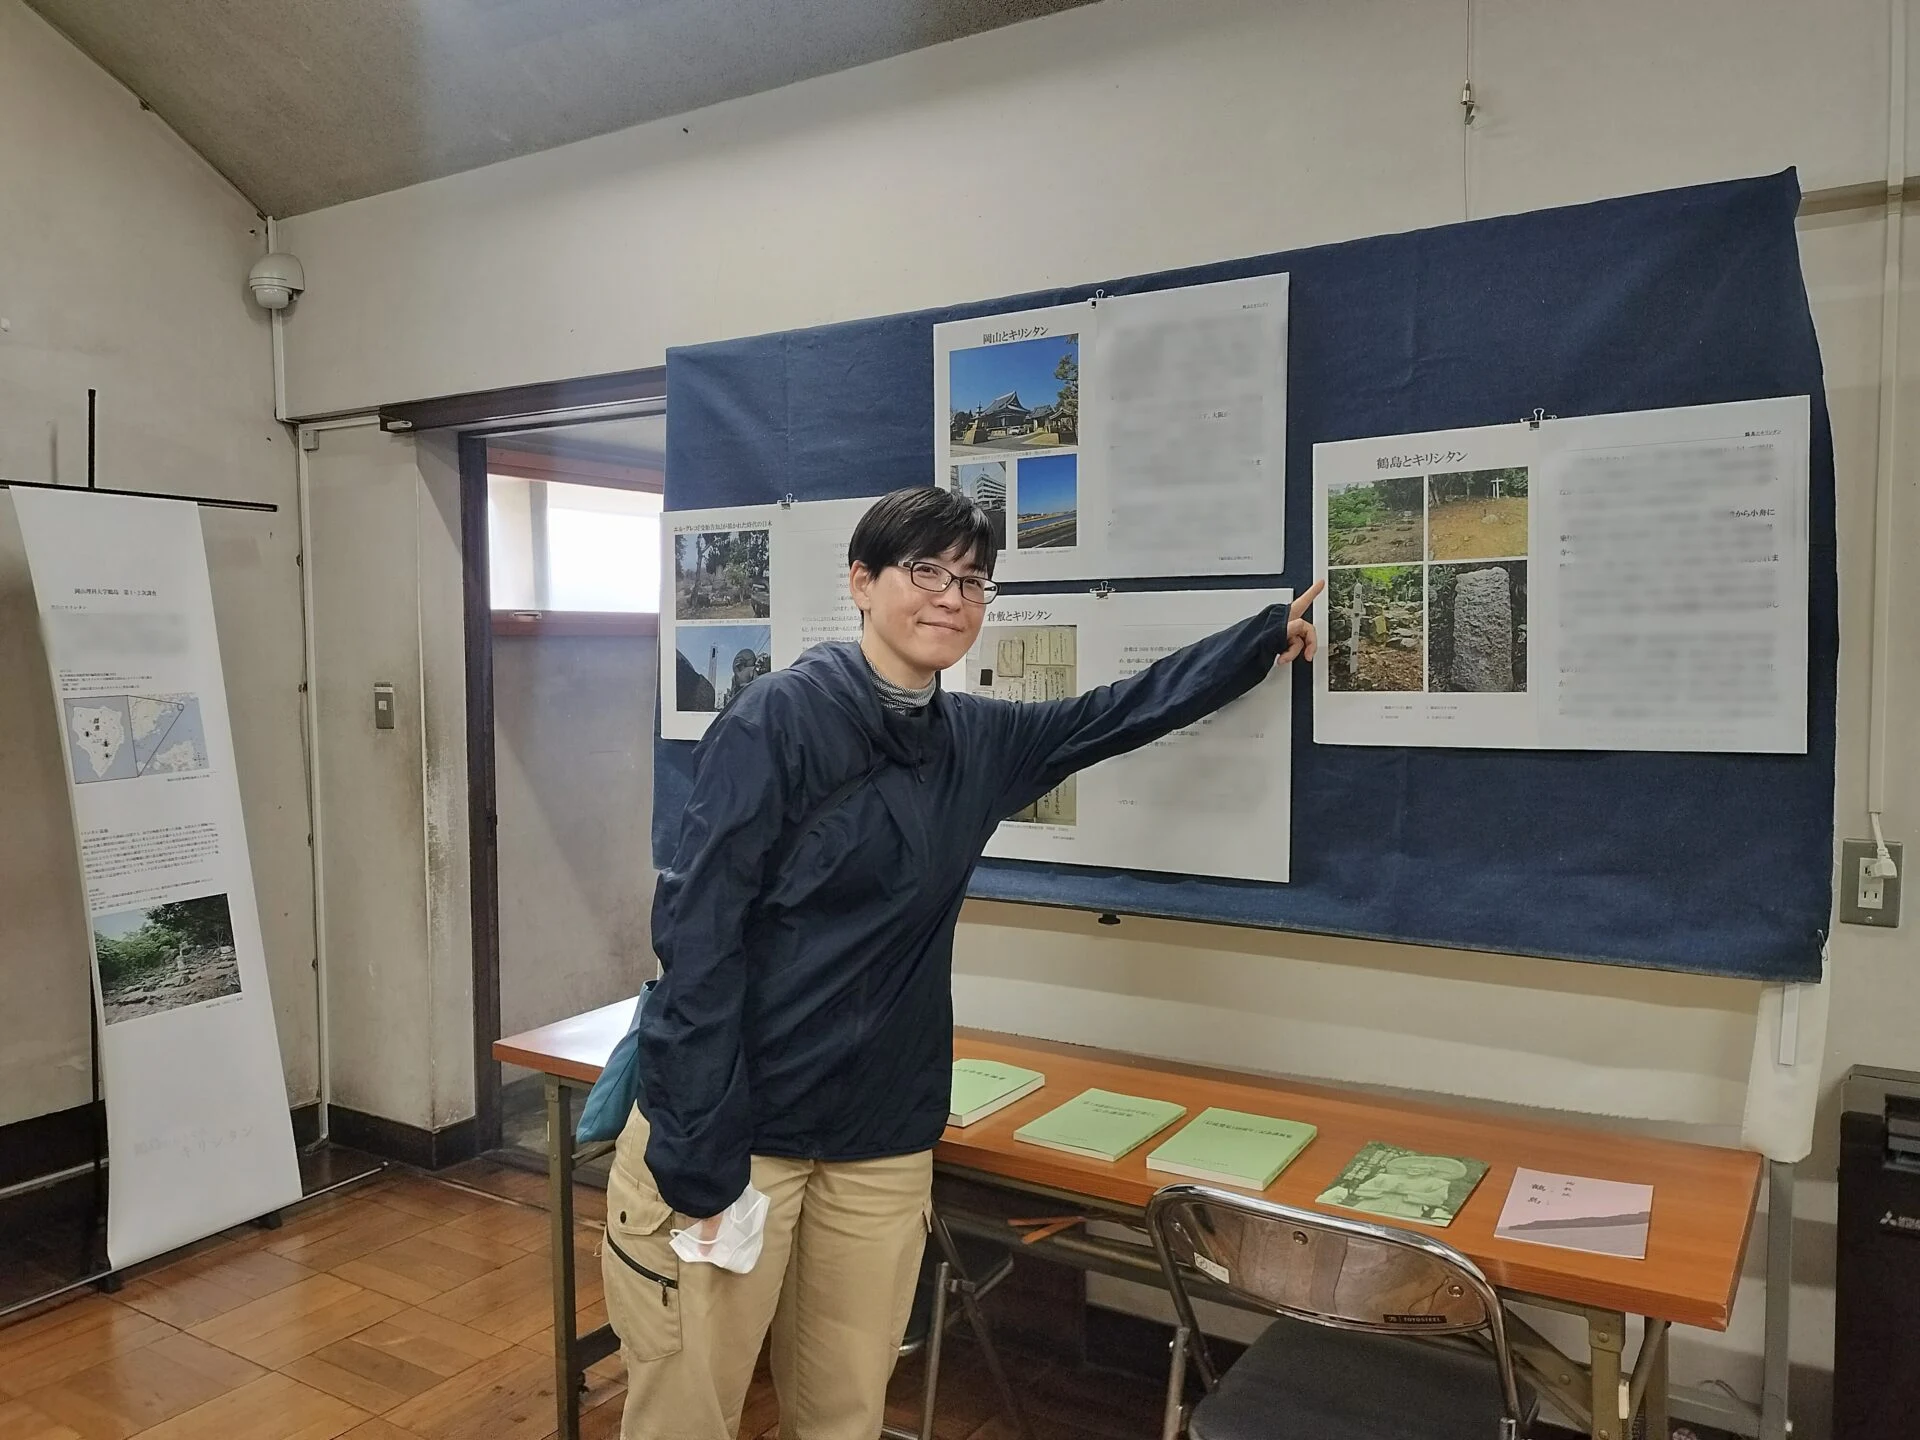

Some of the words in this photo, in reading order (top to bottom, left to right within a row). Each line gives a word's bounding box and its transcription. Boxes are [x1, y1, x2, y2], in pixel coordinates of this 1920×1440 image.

[983, 326, 1049, 344] 岡山とキリシタン
[1376, 450, 1468, 469] 鶴島とキリシタン
[987, 610, 1053, 622] 倉敷とキリシタン
